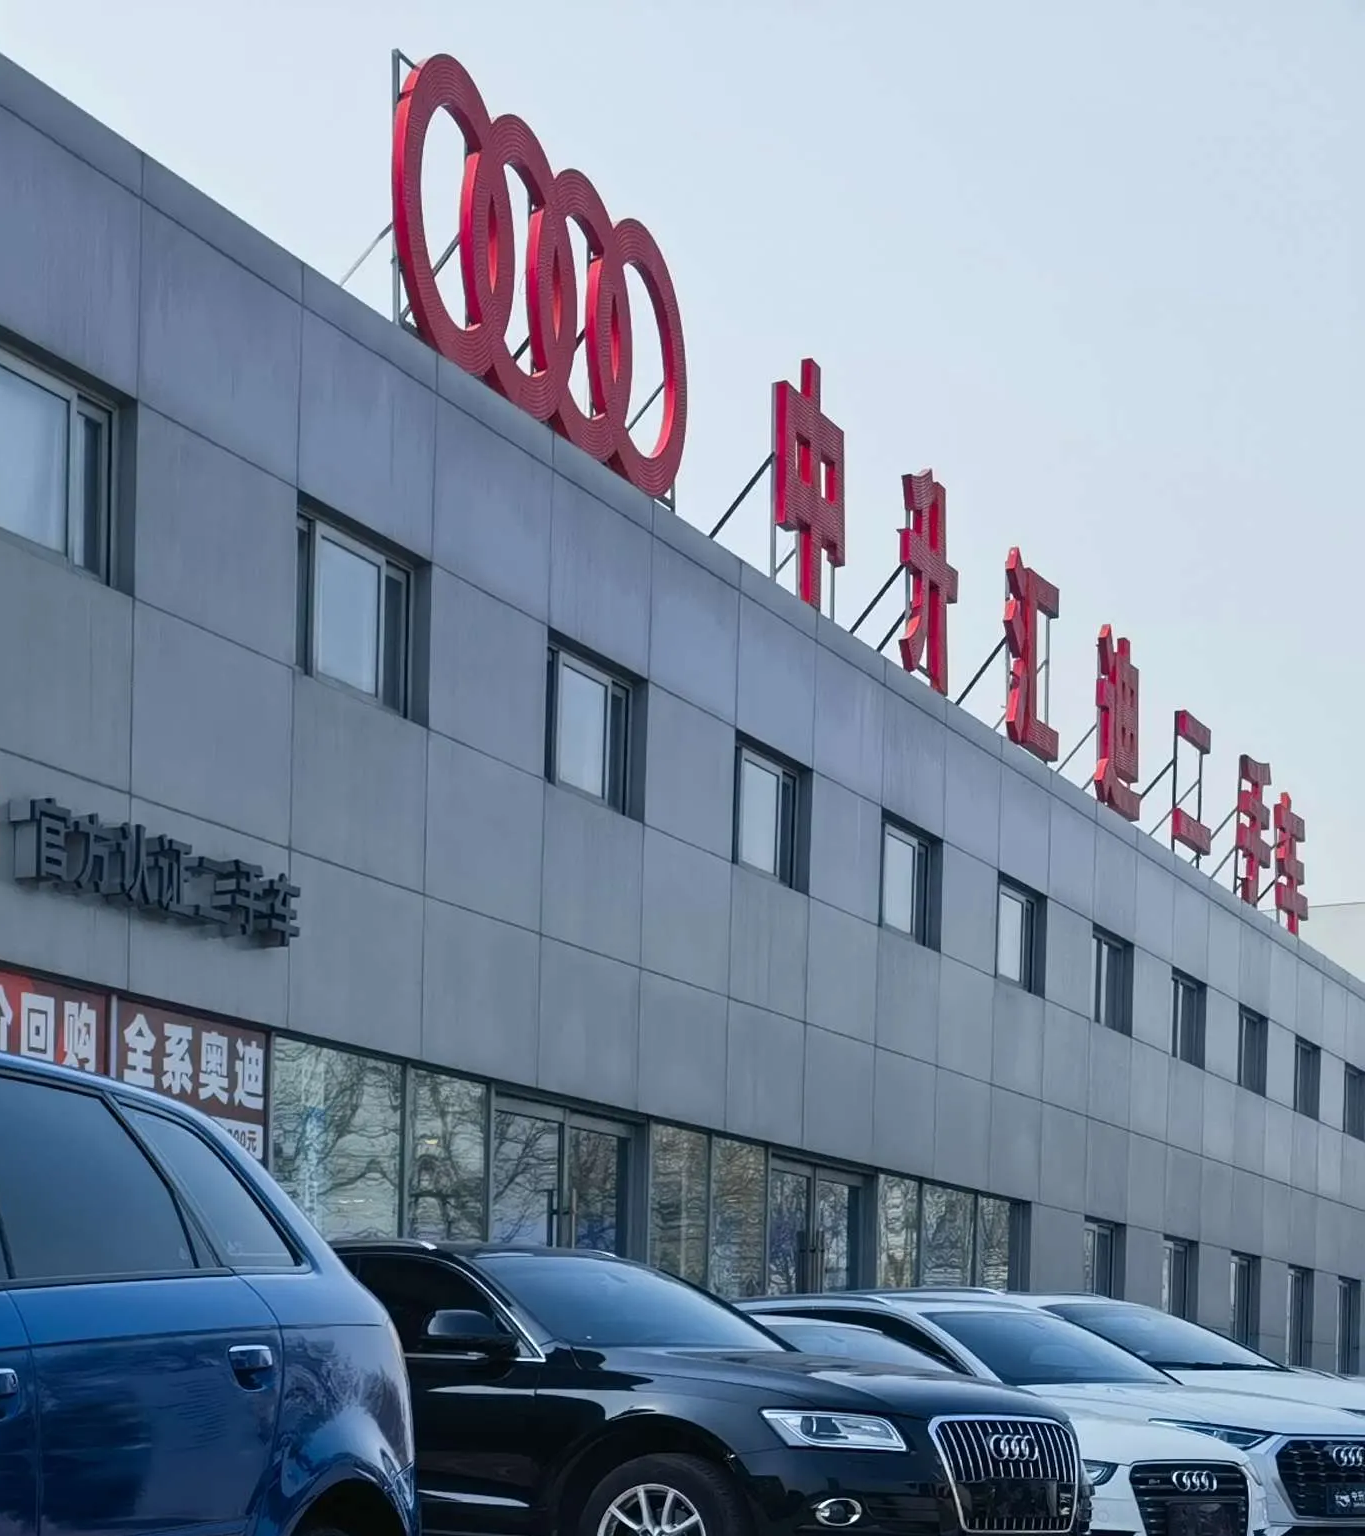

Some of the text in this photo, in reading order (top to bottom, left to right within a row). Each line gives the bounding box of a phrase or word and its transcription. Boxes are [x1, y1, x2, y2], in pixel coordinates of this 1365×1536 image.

[11, 798, 301, 947] 官方认证二手车
[123, 1013, 263, 1110] 全系奥迪
